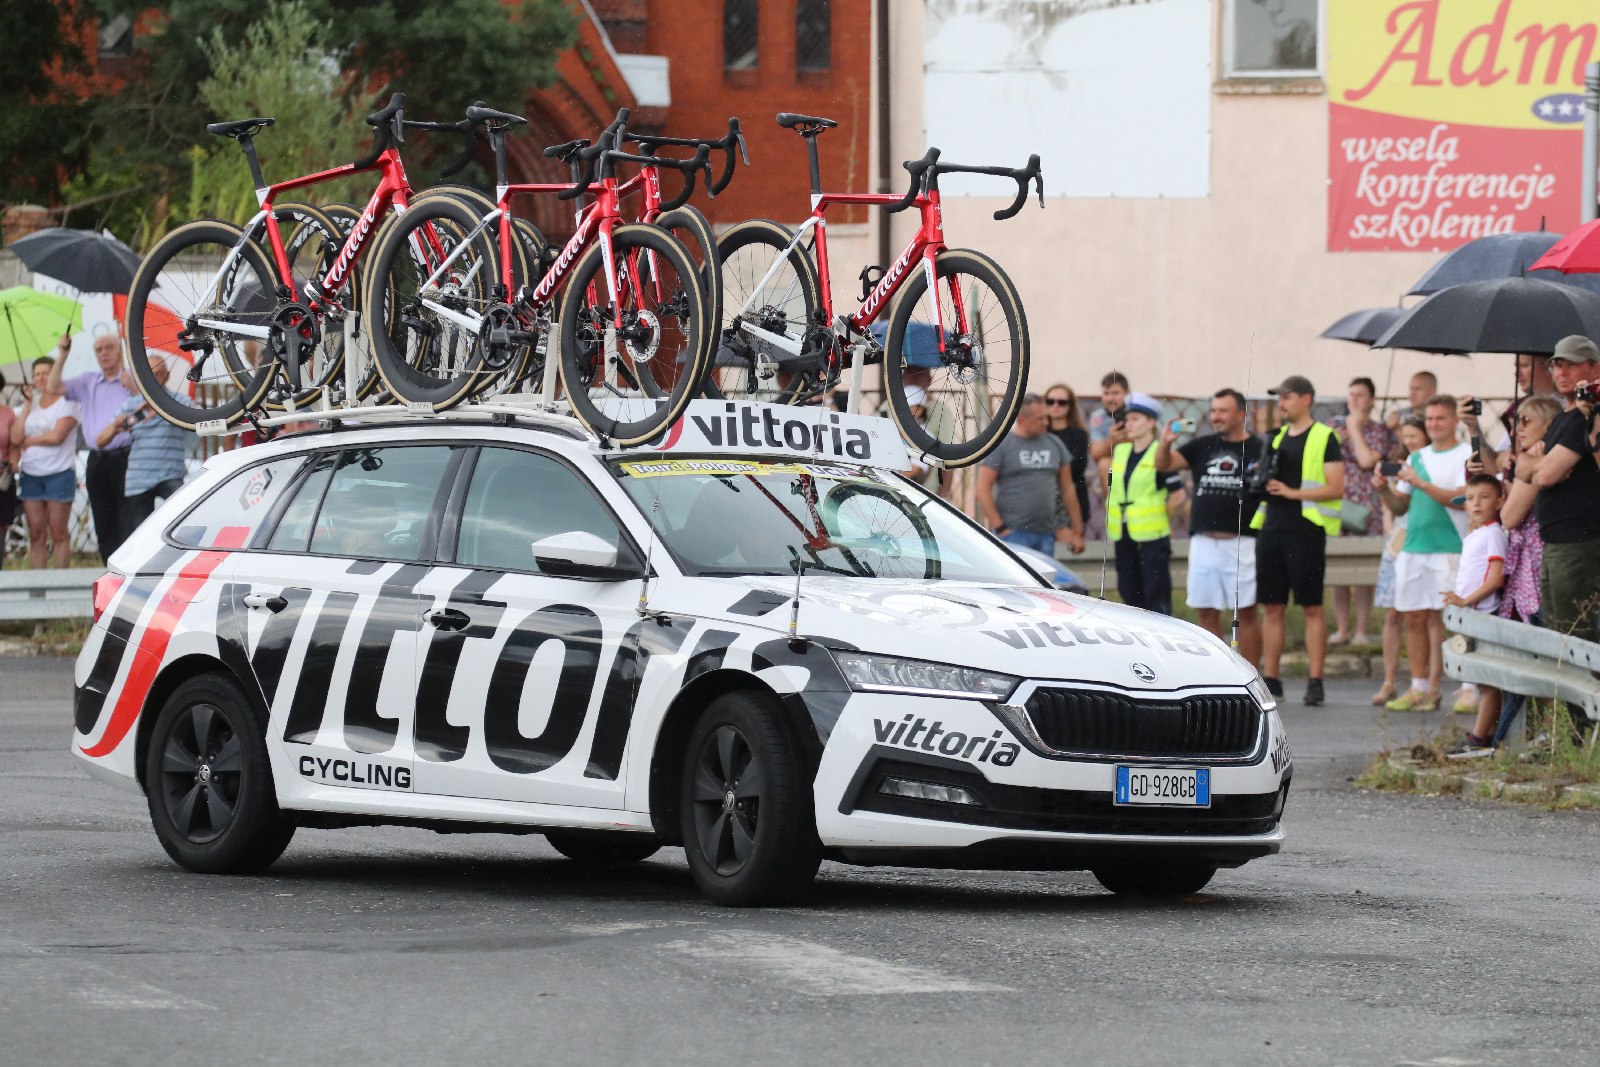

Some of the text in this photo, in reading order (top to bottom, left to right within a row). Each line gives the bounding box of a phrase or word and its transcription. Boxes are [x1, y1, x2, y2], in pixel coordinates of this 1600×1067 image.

[1341, 124, 1460, 162] wesela
[1356, 161, 1556, 210] konferencje
[1349, 202, 1516, 247] szkolenia
[691, 402, 871, 460] vittoria
[1019, 449, 1053, 465] EA7
[979, 621, 1211, 657] vittoria
[873, 713, 1022, 767] vittoria
[299, 756, 412, 788] CYCLING
